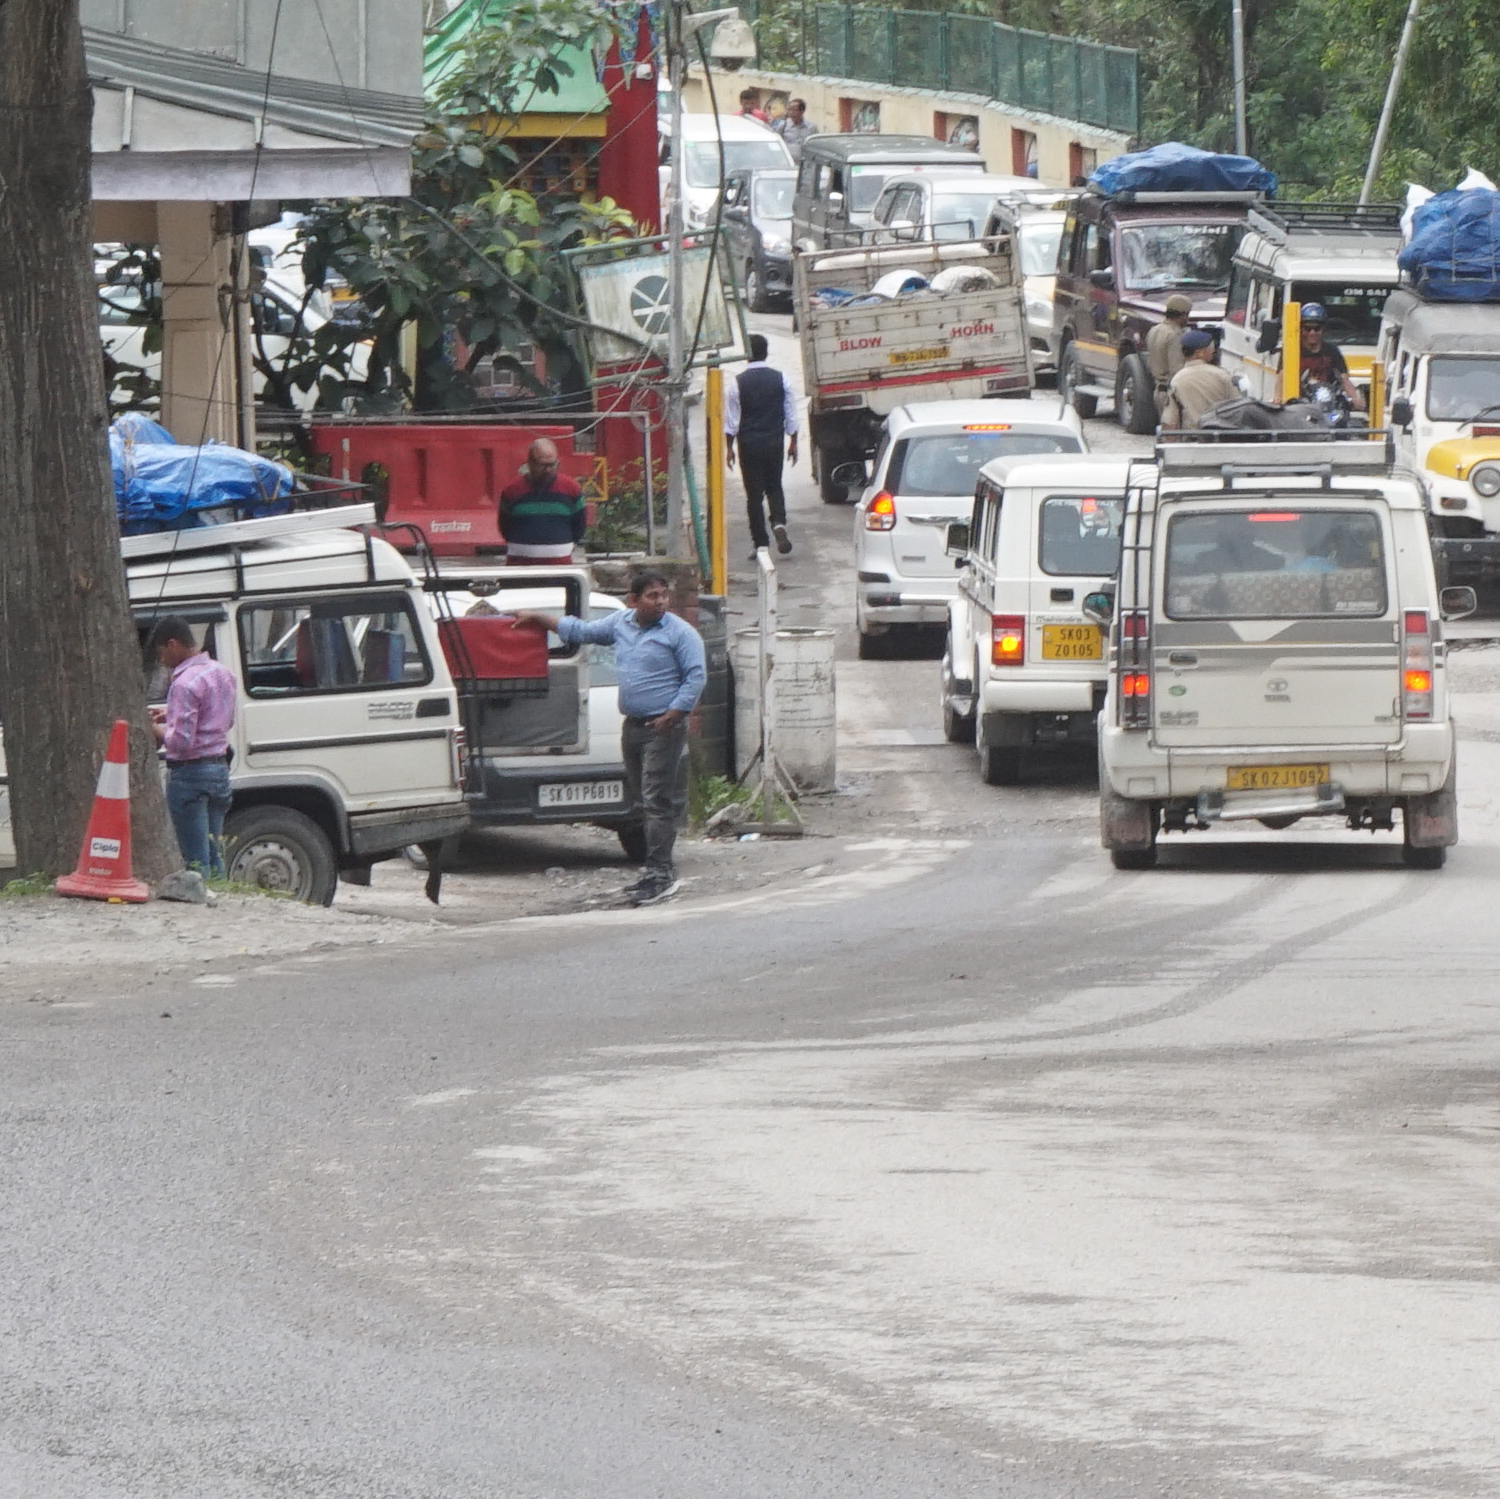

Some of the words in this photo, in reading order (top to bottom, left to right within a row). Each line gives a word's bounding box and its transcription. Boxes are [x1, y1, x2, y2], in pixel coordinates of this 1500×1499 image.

[951, 322, 995, 338] HORN
[839, 336, 882, 351] BLOW
[1059, 628, 1092, 641] SK03
[1054, 643, 1094, 658] Z0105
